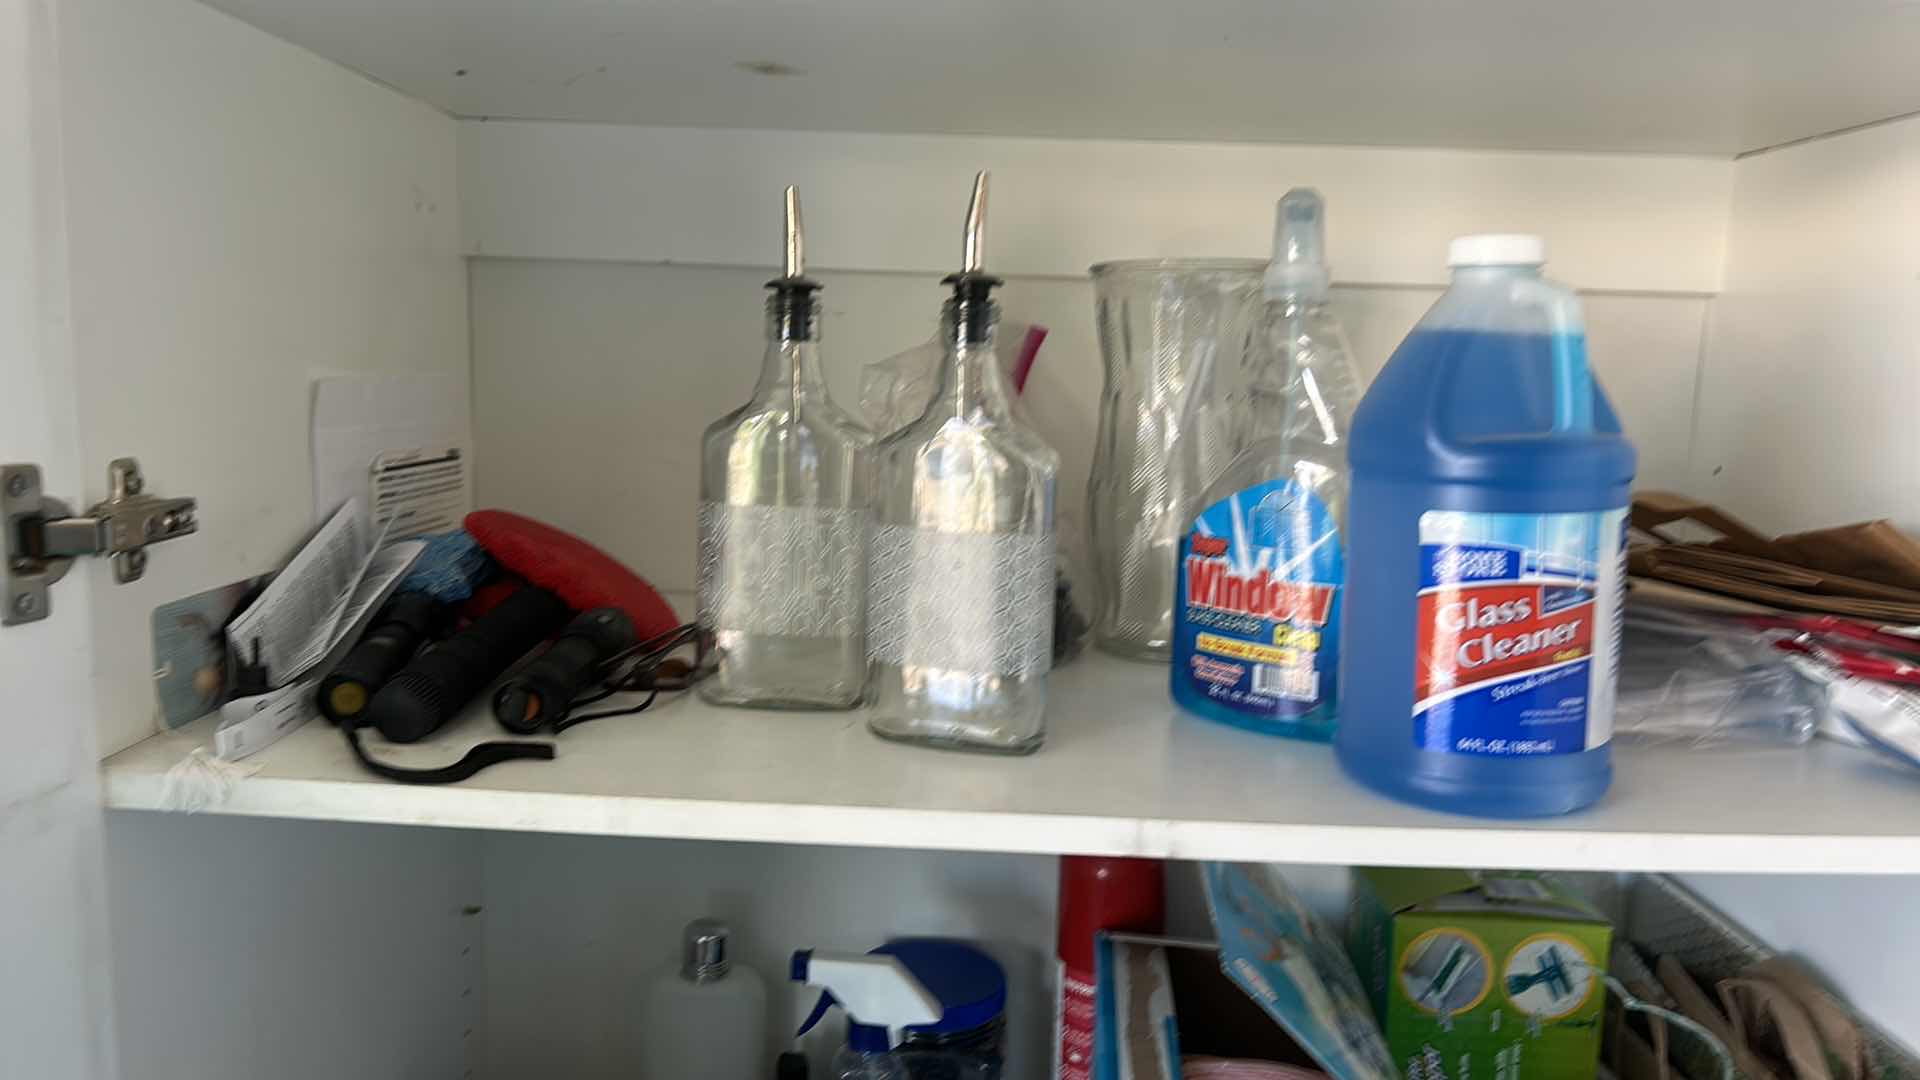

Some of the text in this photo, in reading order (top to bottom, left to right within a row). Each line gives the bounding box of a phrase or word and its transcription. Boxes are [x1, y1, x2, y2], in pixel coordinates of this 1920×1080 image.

[1187, 556, 1335, 627] Window
[1436, 596, 1532, 634] Glass
[1456, 619, 1582, 669] Cleaner
